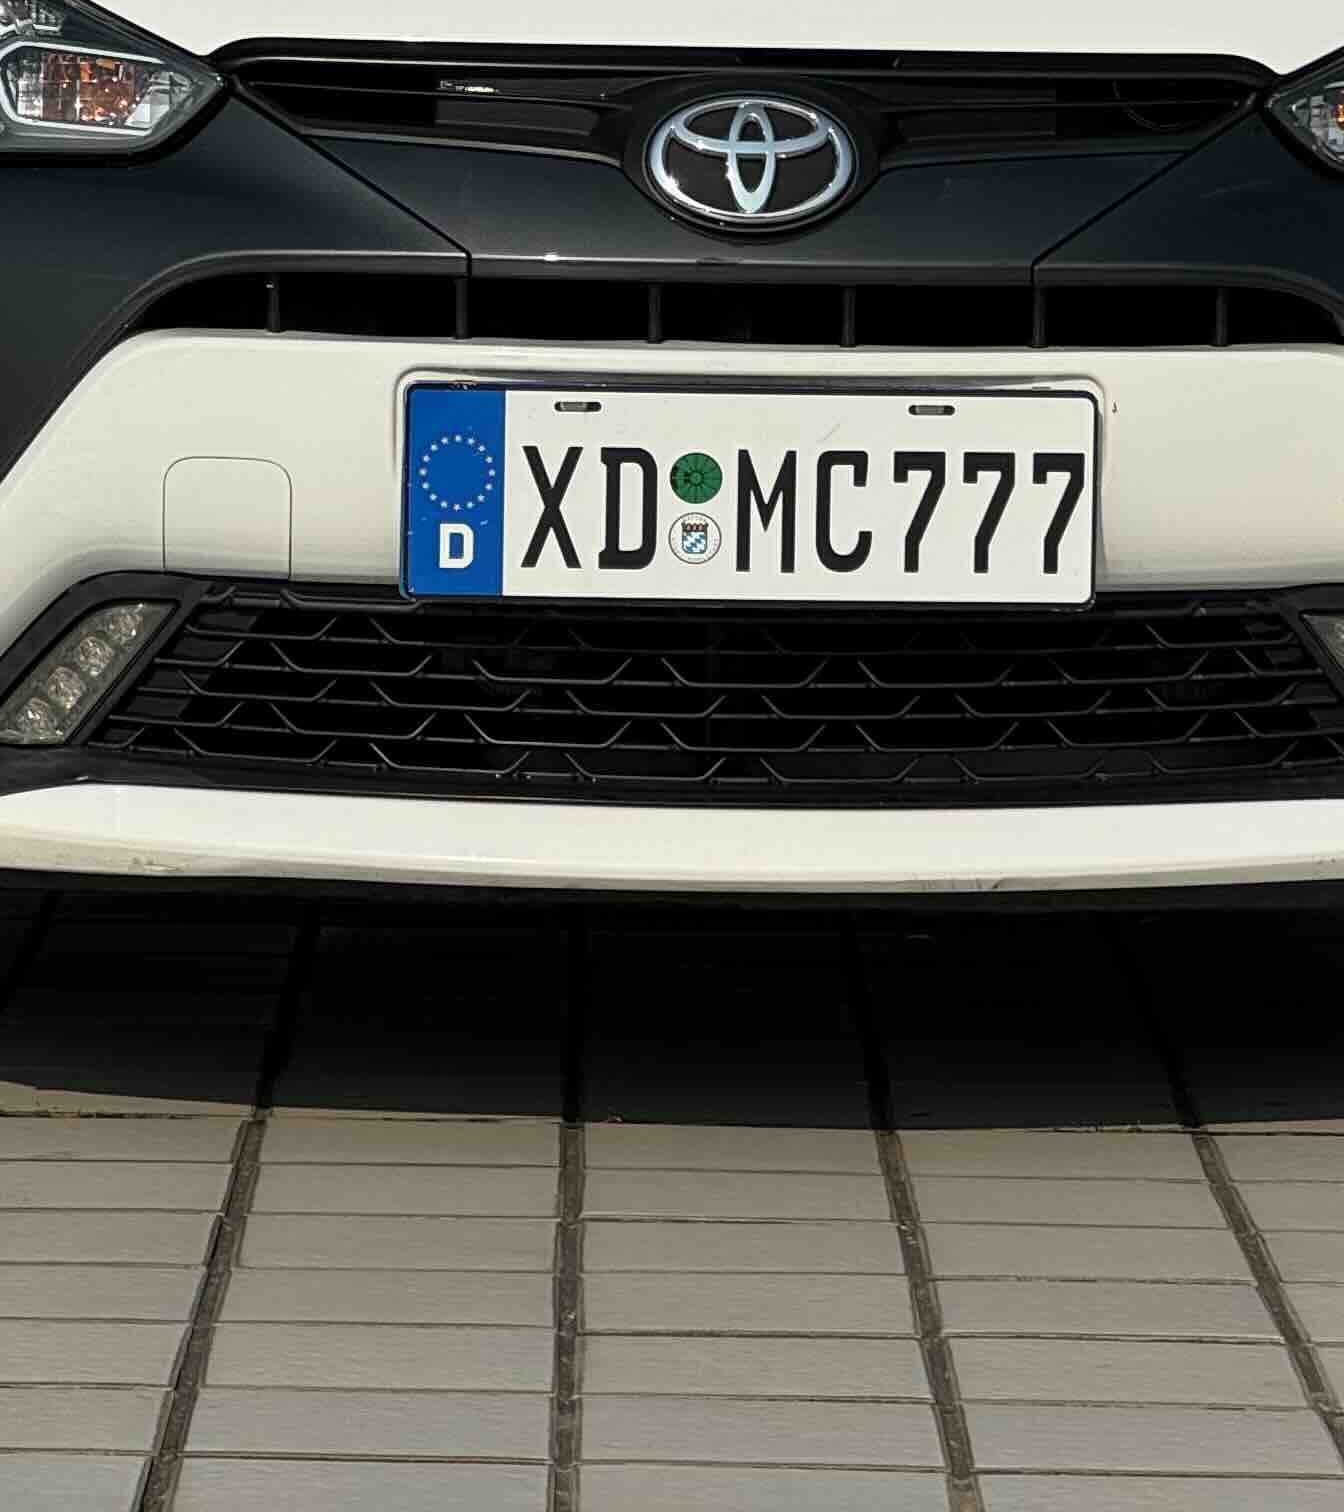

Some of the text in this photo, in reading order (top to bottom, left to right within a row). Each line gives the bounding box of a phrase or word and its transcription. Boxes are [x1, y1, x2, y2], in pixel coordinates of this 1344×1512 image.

[439, 523, 474, 569] D
[521, 446, 1085, 574] XD MC777
